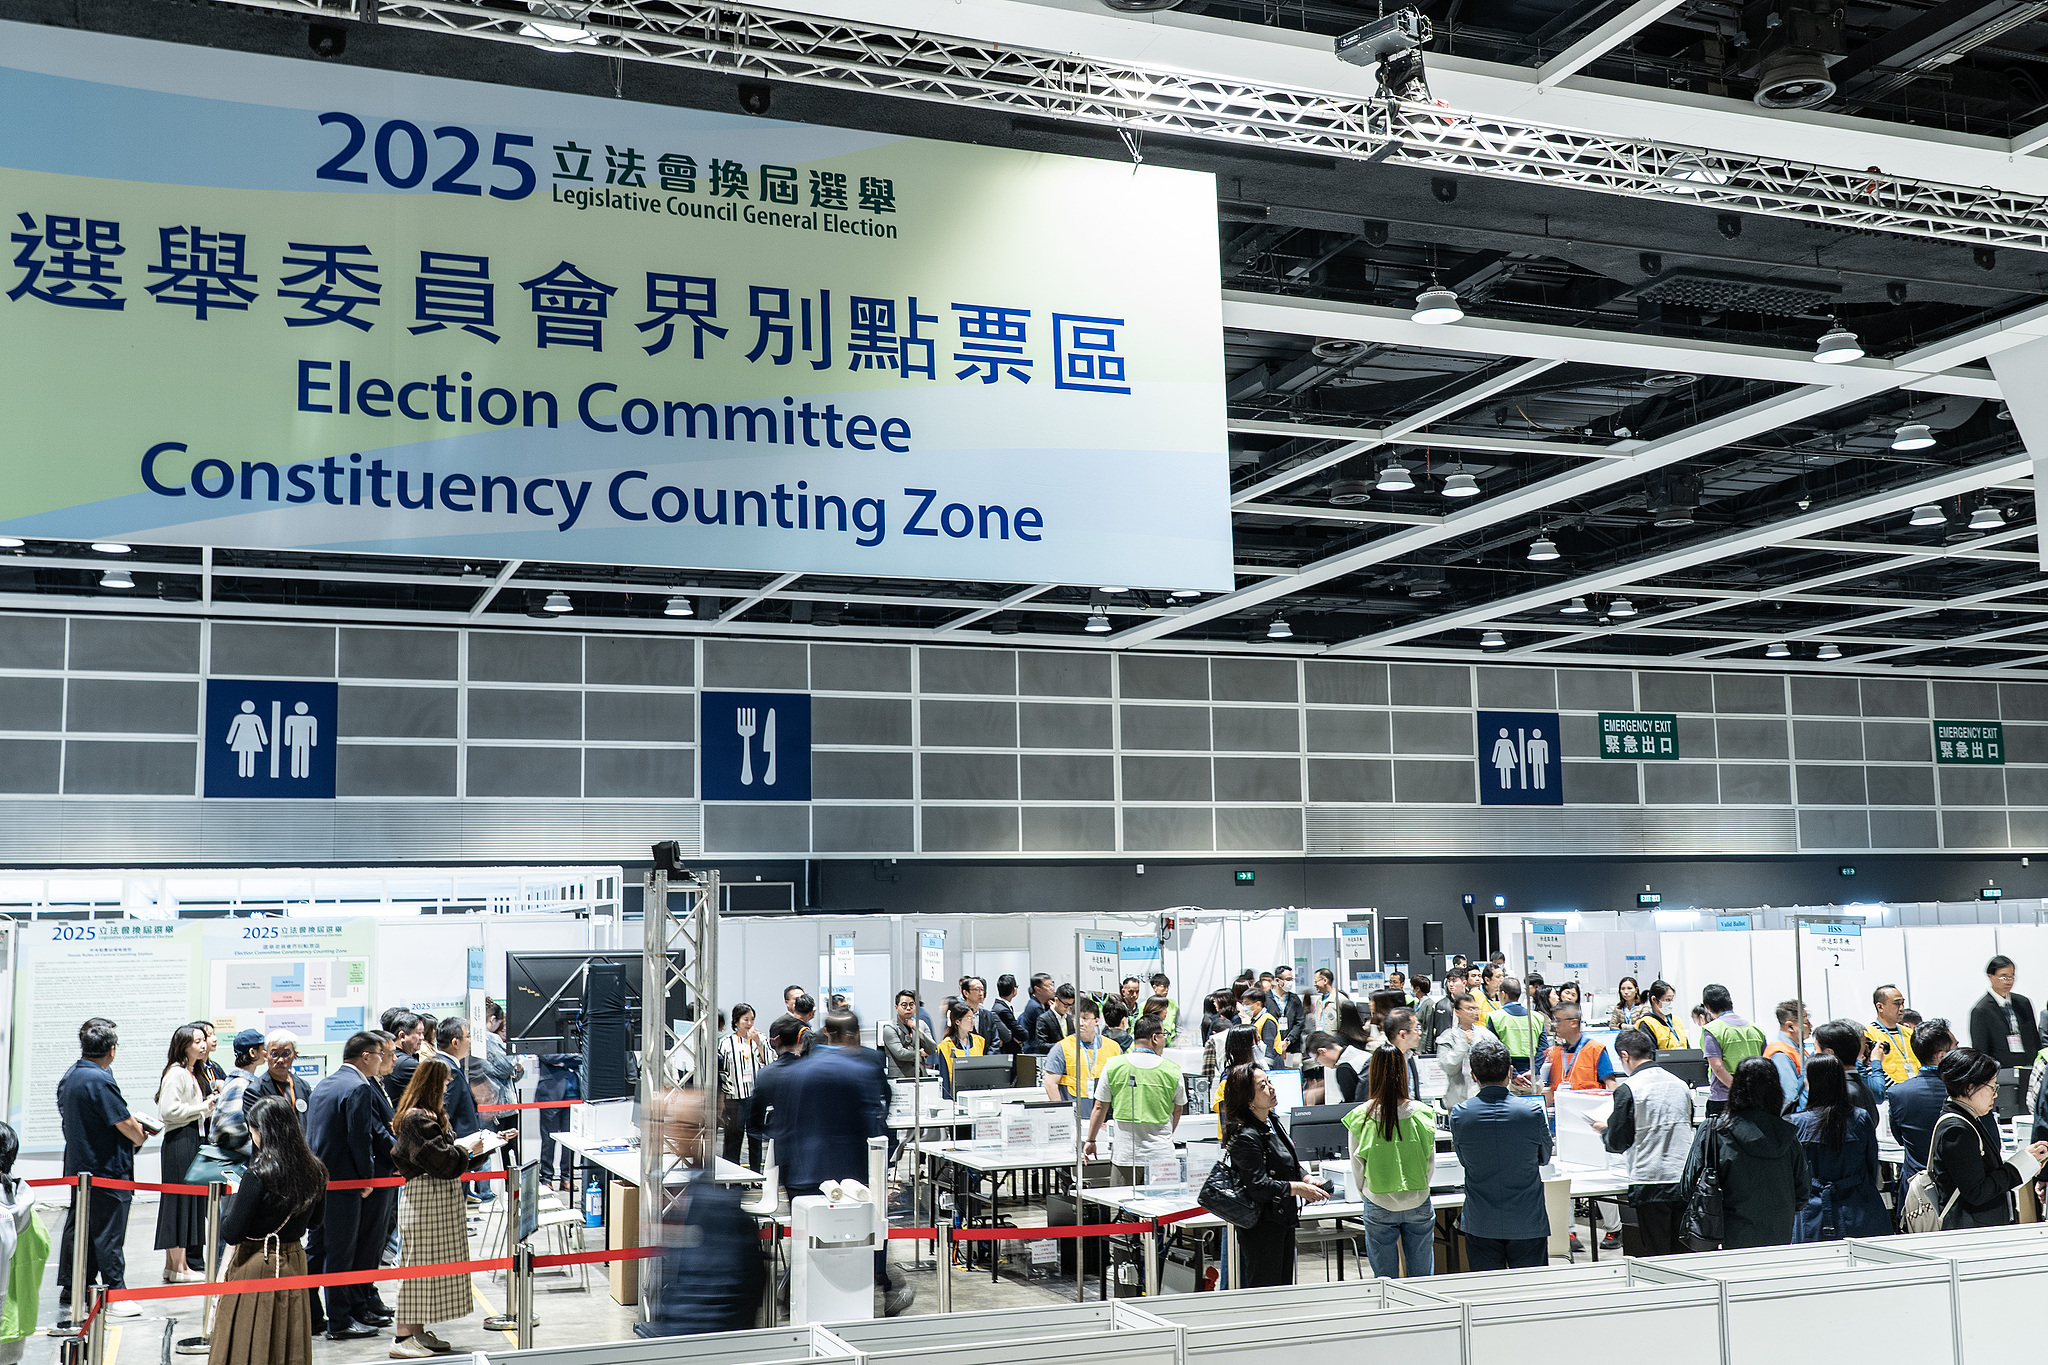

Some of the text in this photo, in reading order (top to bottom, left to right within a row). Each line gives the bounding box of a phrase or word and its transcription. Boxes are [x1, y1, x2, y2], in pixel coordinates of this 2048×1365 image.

[317, 112, 537, 201] 2025
[553, 141, 897, 215] 立法會換屆選舉
[552, 183, 898, 239] Legislative Council General Election
[6, 212, 1132, 395] 選舉委員會界別點票區
[297, 359, 911, 453] Election Committee
[141, 442, 1044, 547] Constituency Counting Zone
[1603, 719, 1671, 732] EMERGENCY EXIT
[1938, 726, 1997, 738] EMERGENCY EXIT
[1604, 734, 1672, 753] 緊急出口
[1940, 741, 1998, 758] 緊急出口
[52, 926, 96, 941] 2025
[242, 926, 279, 939] 2025
[1828, 925, 1842, 933] HSS
[1354, 949, 1358, 957] 6
[1547, 950, 1552, 960] 4
[1833, 954, 1840, 966] 2
[411, 1002, 431, 1010] 2025
